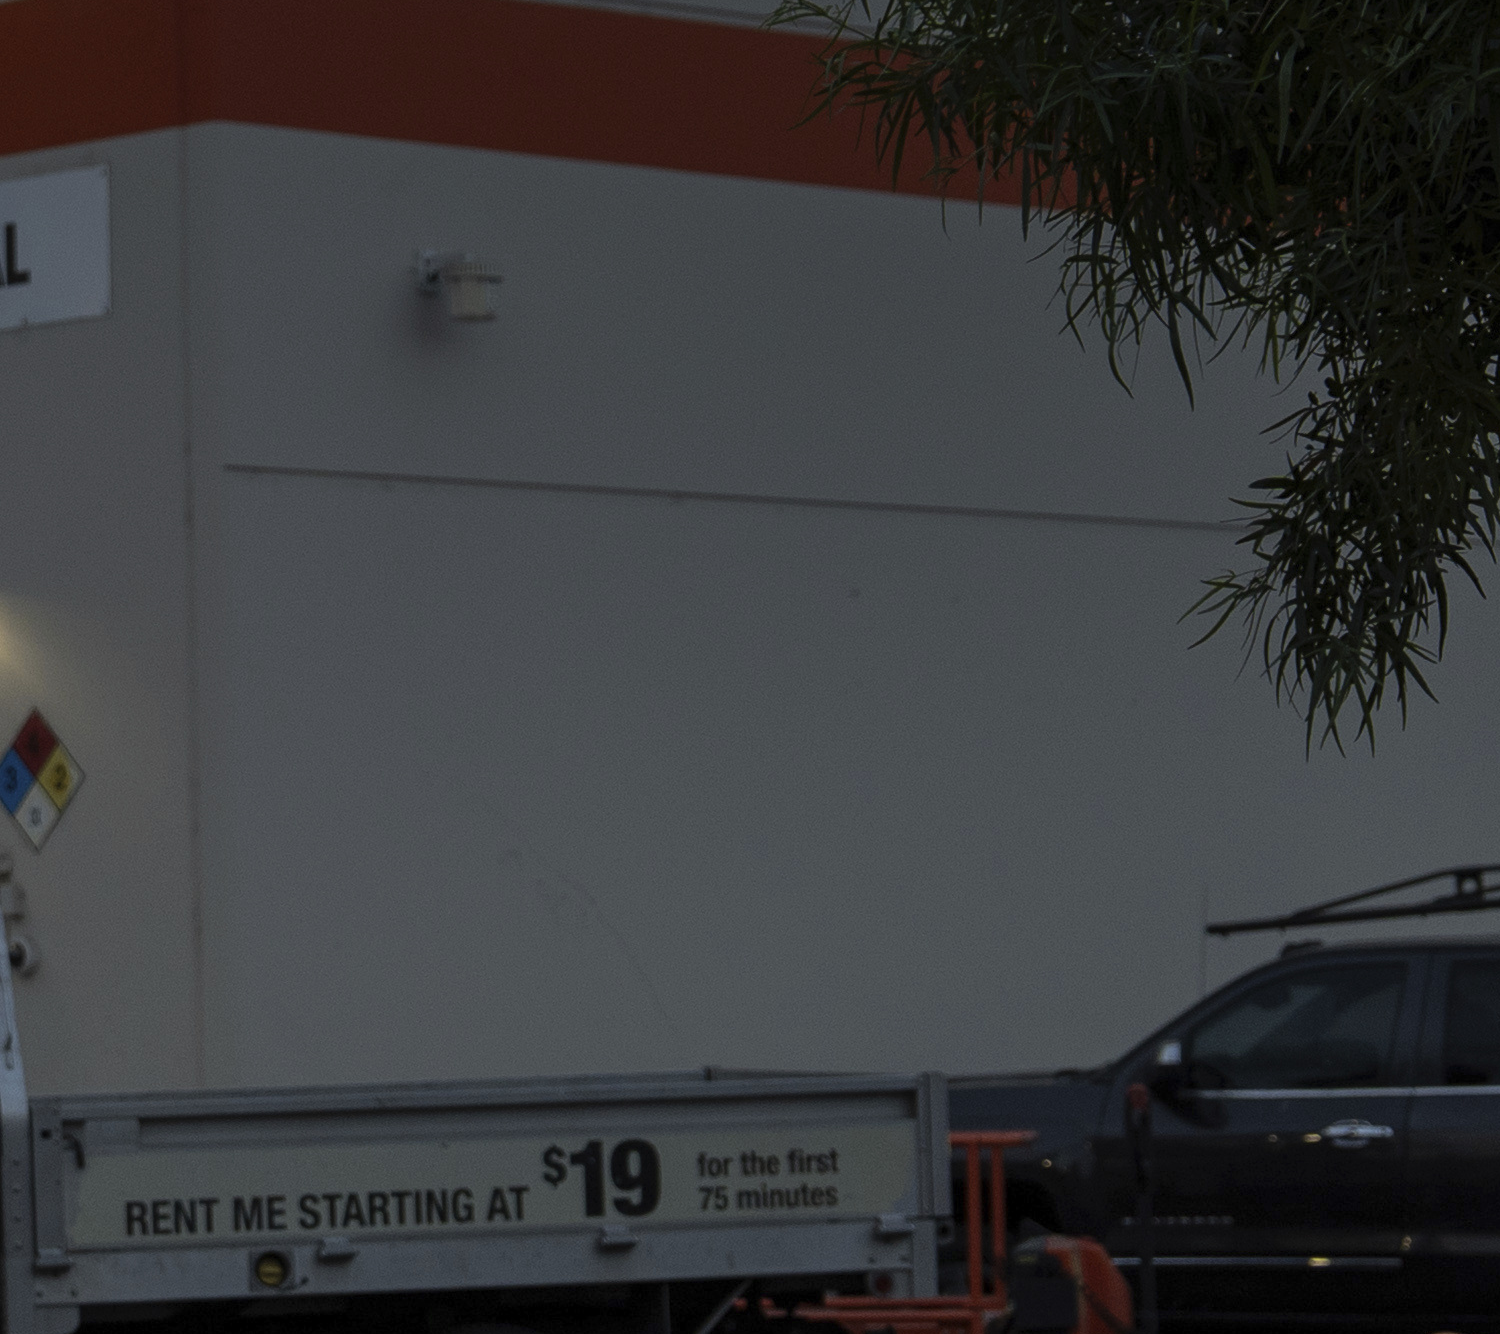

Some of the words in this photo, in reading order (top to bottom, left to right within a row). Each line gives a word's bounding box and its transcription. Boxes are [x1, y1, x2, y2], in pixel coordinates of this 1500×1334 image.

[698, 1151, 733, 1178] for
[741, 1150, 780, 1177] the
[787, 1147, 839, 1174] first
[125, 1197, 219, 1236] RENT
[233, 1195, 288, 1232] ME
[299, 1187, 475, 1230] STARTING
[487, 1186, 531, 1222] AT
[543, 1138, 661, 1217] $19
[699, 1185, 728, 1211] 75
[736, 1182, 839, 1210] minutes
